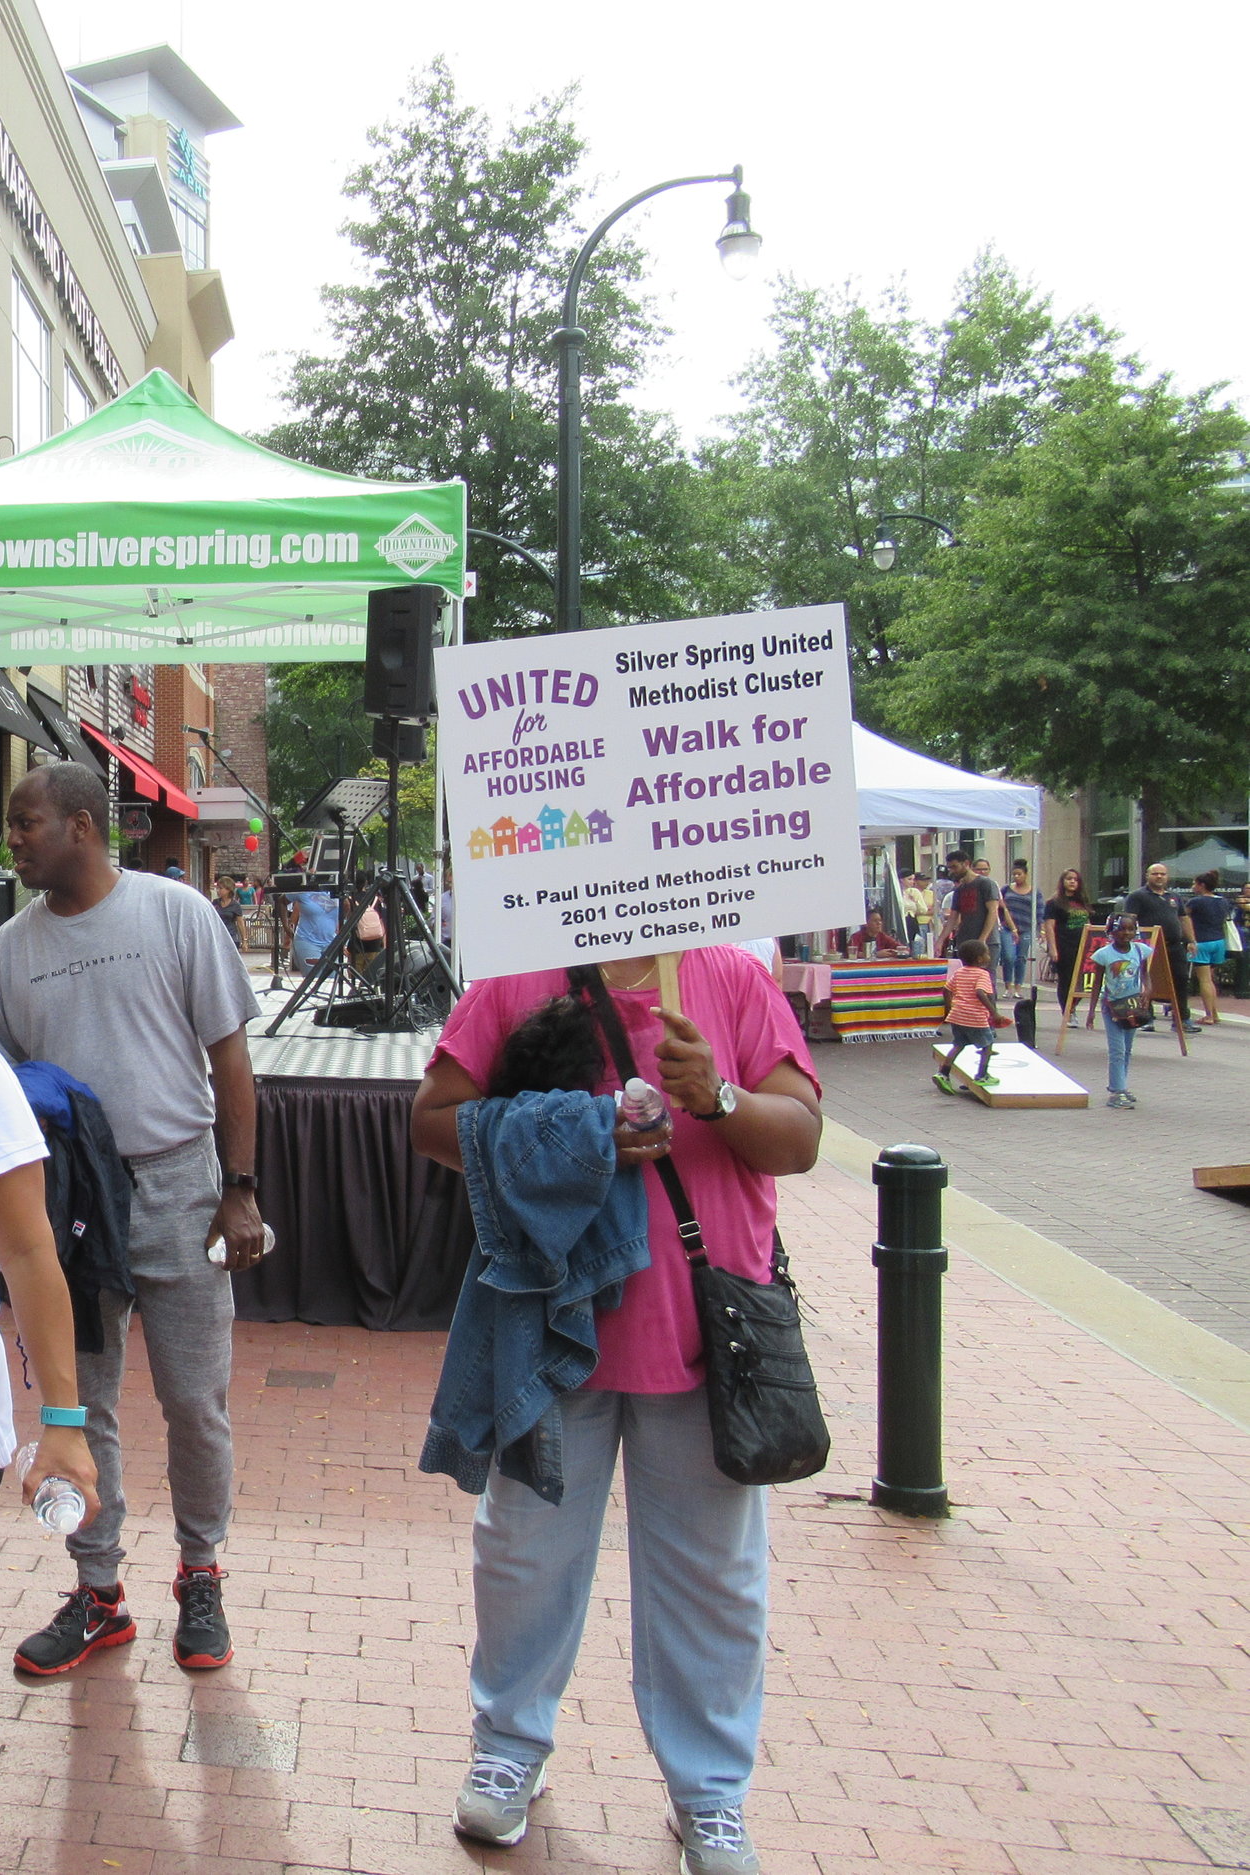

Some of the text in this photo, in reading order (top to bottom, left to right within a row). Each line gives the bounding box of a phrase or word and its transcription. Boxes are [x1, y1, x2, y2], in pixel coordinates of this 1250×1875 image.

[61, 251, 94, 347] YOUTH
[383, 537, 450, 553] DOWNTOWN
[615, 629, 834, 674] Silver Spring United
[457, 668, 599, 720] UNITED
[628, 668, 824, 708] Methodist Cluster
[512, 708, 548, 745] for
[642, 713, 809, 757] Walk for
[463, 737, 606, 774] AFFORDABLE
[487, 765, 586, 798] HOUSING
[626, 756, 832, 808] Affordable
[651, 809, 811, 851] Housing
[502, 852, 826, 910] St. Paul United Methodist Church
[561, 887, 756, 927] 2601 Coloston Drive
[574, 911, 742, 950] Chevy Chase, MD
[85, 952, 141, 968] AMERICA
